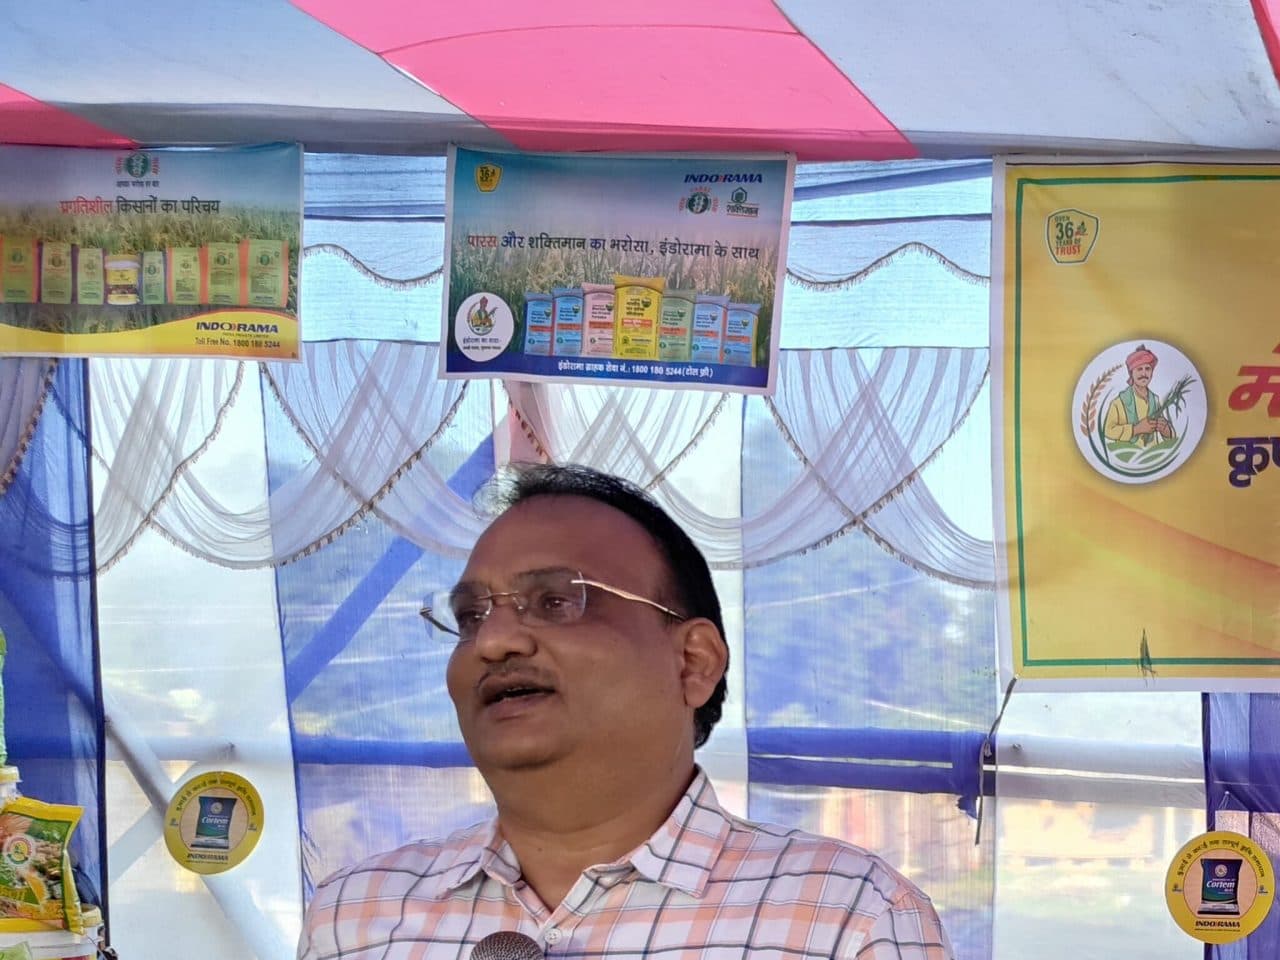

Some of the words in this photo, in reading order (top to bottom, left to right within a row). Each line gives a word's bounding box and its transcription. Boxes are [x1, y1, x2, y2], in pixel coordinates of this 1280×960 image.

[684, 173, 763, 184] INDORAMA
[60, 197, 112, 214] प्रगतिशील
[116, 195, 157, 214] किसानों
[161, 200, 180, 214] का
[181, 196, 221, 214] परिचय
[1056, 222, 1073, 240] 36
[468, 234, 497, 247] पारस
[501, 231, 525, 248] और
[528, 232, 586, 250] शक्तिमान
[590, 237, 607, 250] का
[659, 236, 710, 256] इंडोरामा
[714, 239, 728, 258] के
[731, 246, 760, 260] साथ
[1056, 245, 1081, 255] TRUST
[196, 321, 279, 334] INDORAMA
